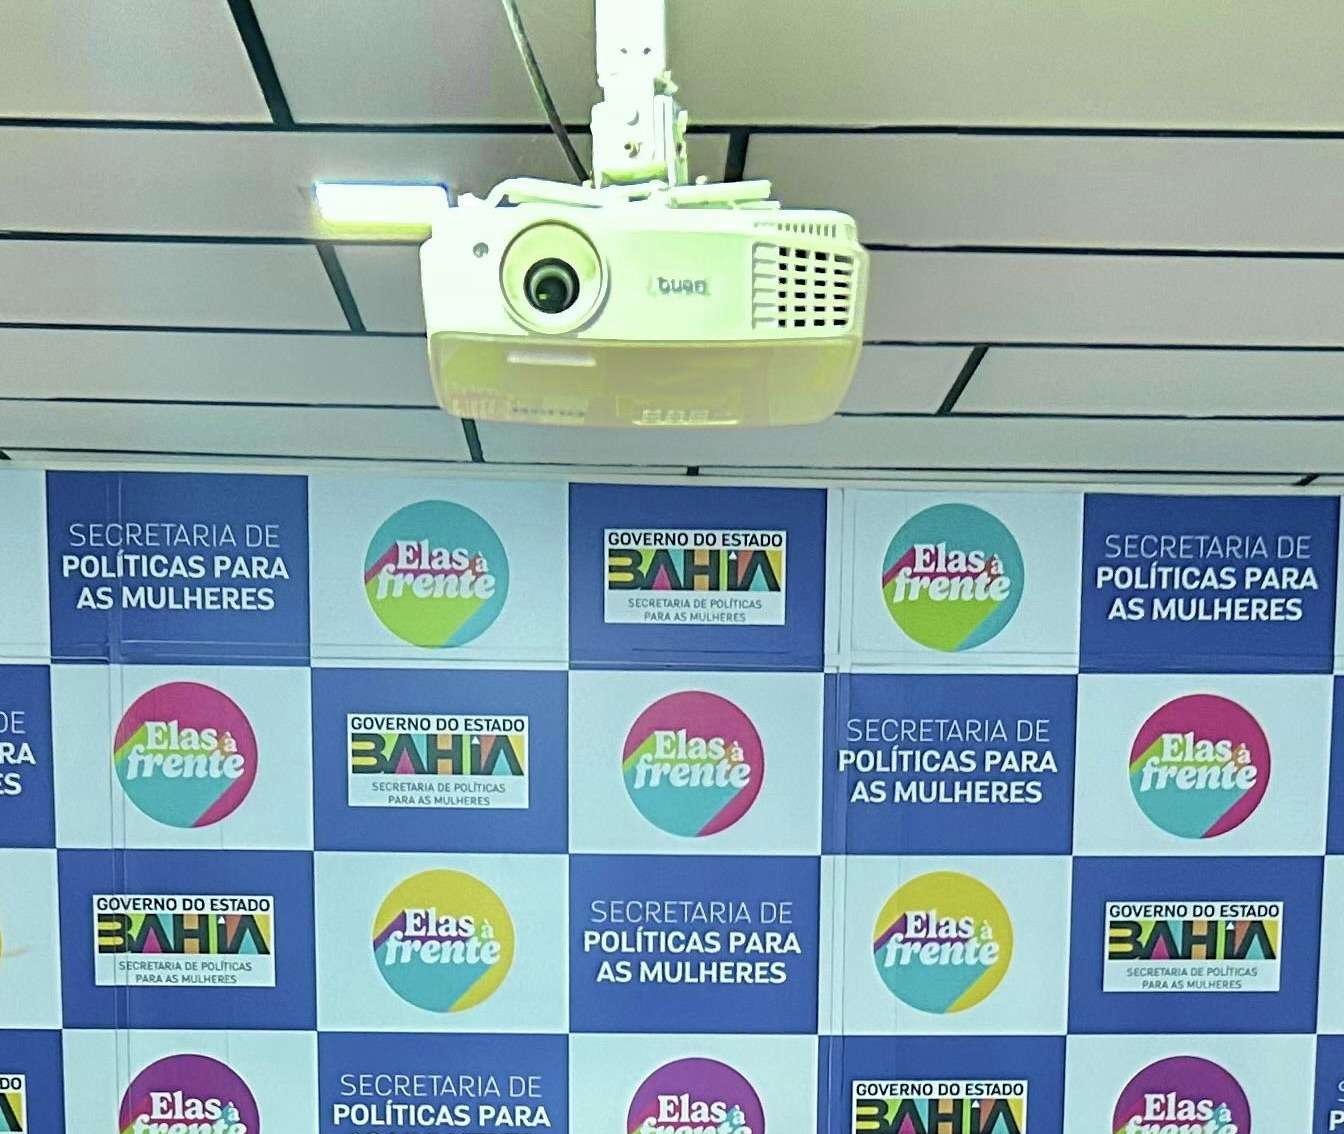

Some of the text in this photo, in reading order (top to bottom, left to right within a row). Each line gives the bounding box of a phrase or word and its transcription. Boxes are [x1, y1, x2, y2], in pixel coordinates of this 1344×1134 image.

[69, 523, 279, 547] SECRETARIA DE
[609, 532, 782, 547] GOVERNO DO ESTADO
[62, 550, 289, 578] POLÍTICAS PARA
[76, 587, 275, 610] AS MULHERES
[628, 599, 691, 609] SECRETARIA
[694, 599, 706, 609] DE
[644, 613, 746, 622] PARA AS MULHERES
[846, 718, 1049, 742] SECRETARIA DE
[838, 745, 1057, 773] POLÍTICAS PARA
[851, 781, 1042, 803] AS MULHERES
[98, 897, 270, 911] GOVERNO DO ESTADO
[403, 907, 475, 937] Elas
[384, 930, 501, 967] frente
[119, 961, 181, 971] SECRETARIA
[185, 962, 197, 971] DE
[135, 975, 236, 984] PARA AS MULHERES
[340, 1075, 541, 1097] SECRETARIA DE
[856, 1083, 1023, 1097] GOVERNO DO ESTADO
[333, 1100, 551, 1126] POLÍTICAS PARA
[1143, 1092, 1214, 1121] Elas
